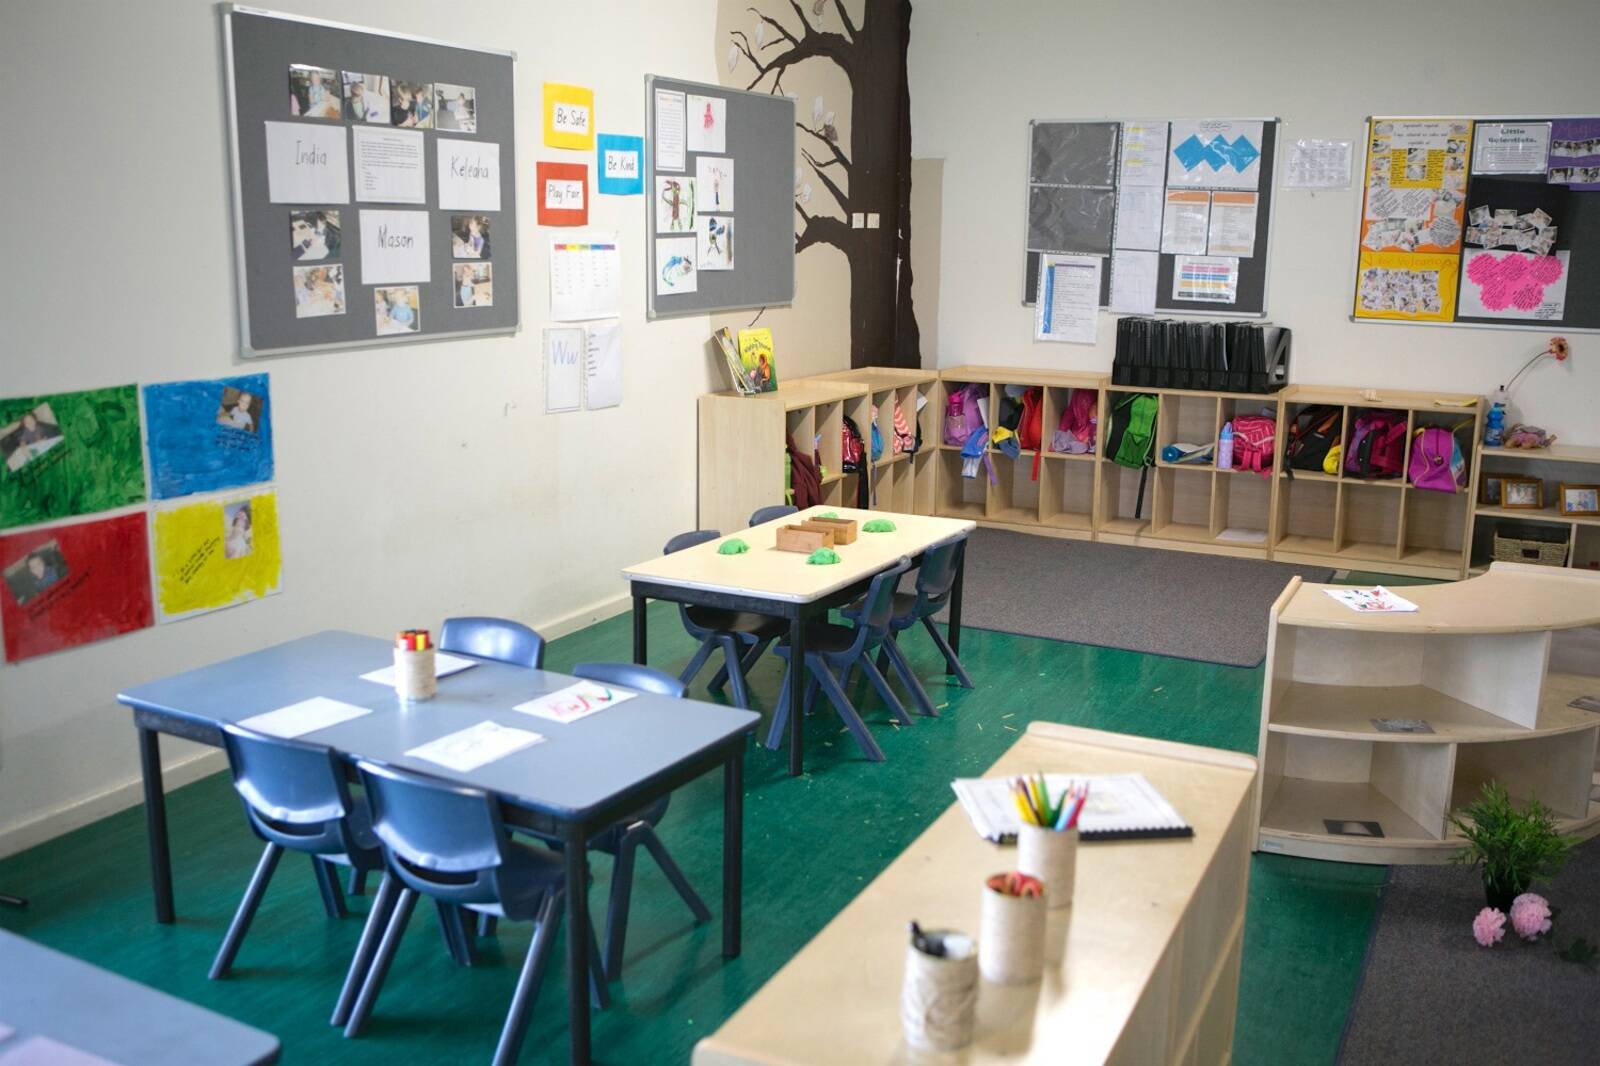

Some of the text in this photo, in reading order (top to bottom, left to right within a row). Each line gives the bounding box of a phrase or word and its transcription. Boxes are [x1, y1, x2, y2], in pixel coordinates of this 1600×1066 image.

[556, 106, 586, 127] Be Safe
[295, 140, 328, 168] India
[607, 155, 635, 172] Be Kind
[548, 183, 580, 204] Play Fair
[377, 224, 415, 249] Mason
[552, 340, 578, 365] Ww
